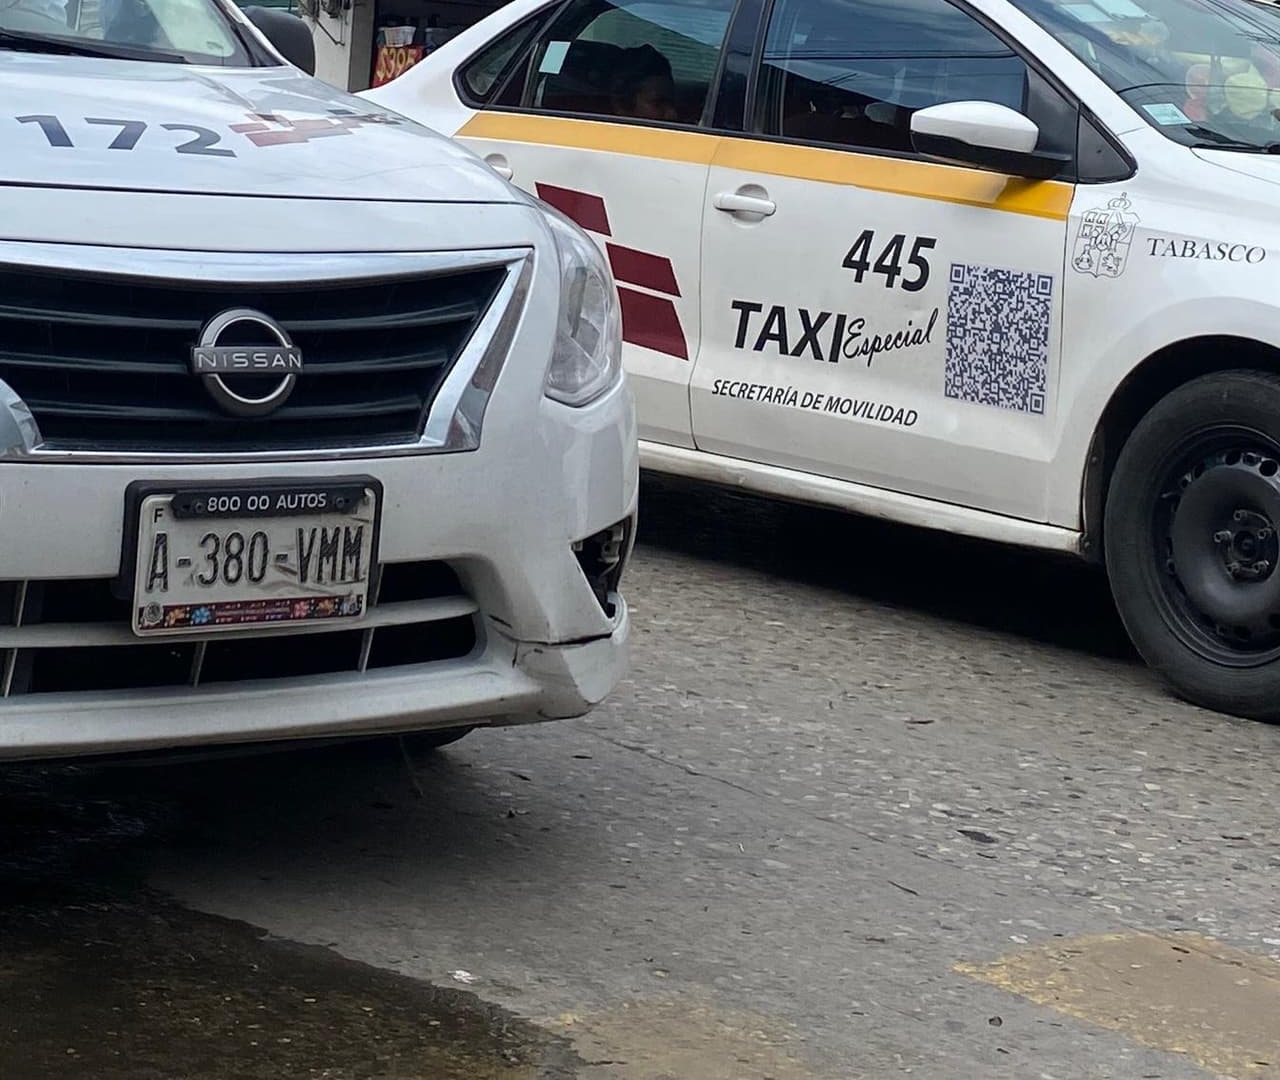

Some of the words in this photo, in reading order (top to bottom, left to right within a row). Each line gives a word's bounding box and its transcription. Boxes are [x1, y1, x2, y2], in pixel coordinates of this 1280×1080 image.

[14, 113, 238, 158] 172
[841, 229, 938, 293] 445
[1146, 236, 1267, 265] TABASCO
[730, 300, 848, 363] TAXI
[843, 307, 939, 368] Especial
[197, 352, 302, 369] NISSAN
[711, 377, 799, 408] SECRETARÍA
[800, 390, 823, 411] DE
[824, 394, 919, 427] MOVILIDAD
[154, 507, 165, 524] F
[206, 496, 241, 512] 800
[247, 494, 270, 512] 00
[276, 493, 327, 510] AUTOS
[145, 525, 365, 594] A-380-VMM
